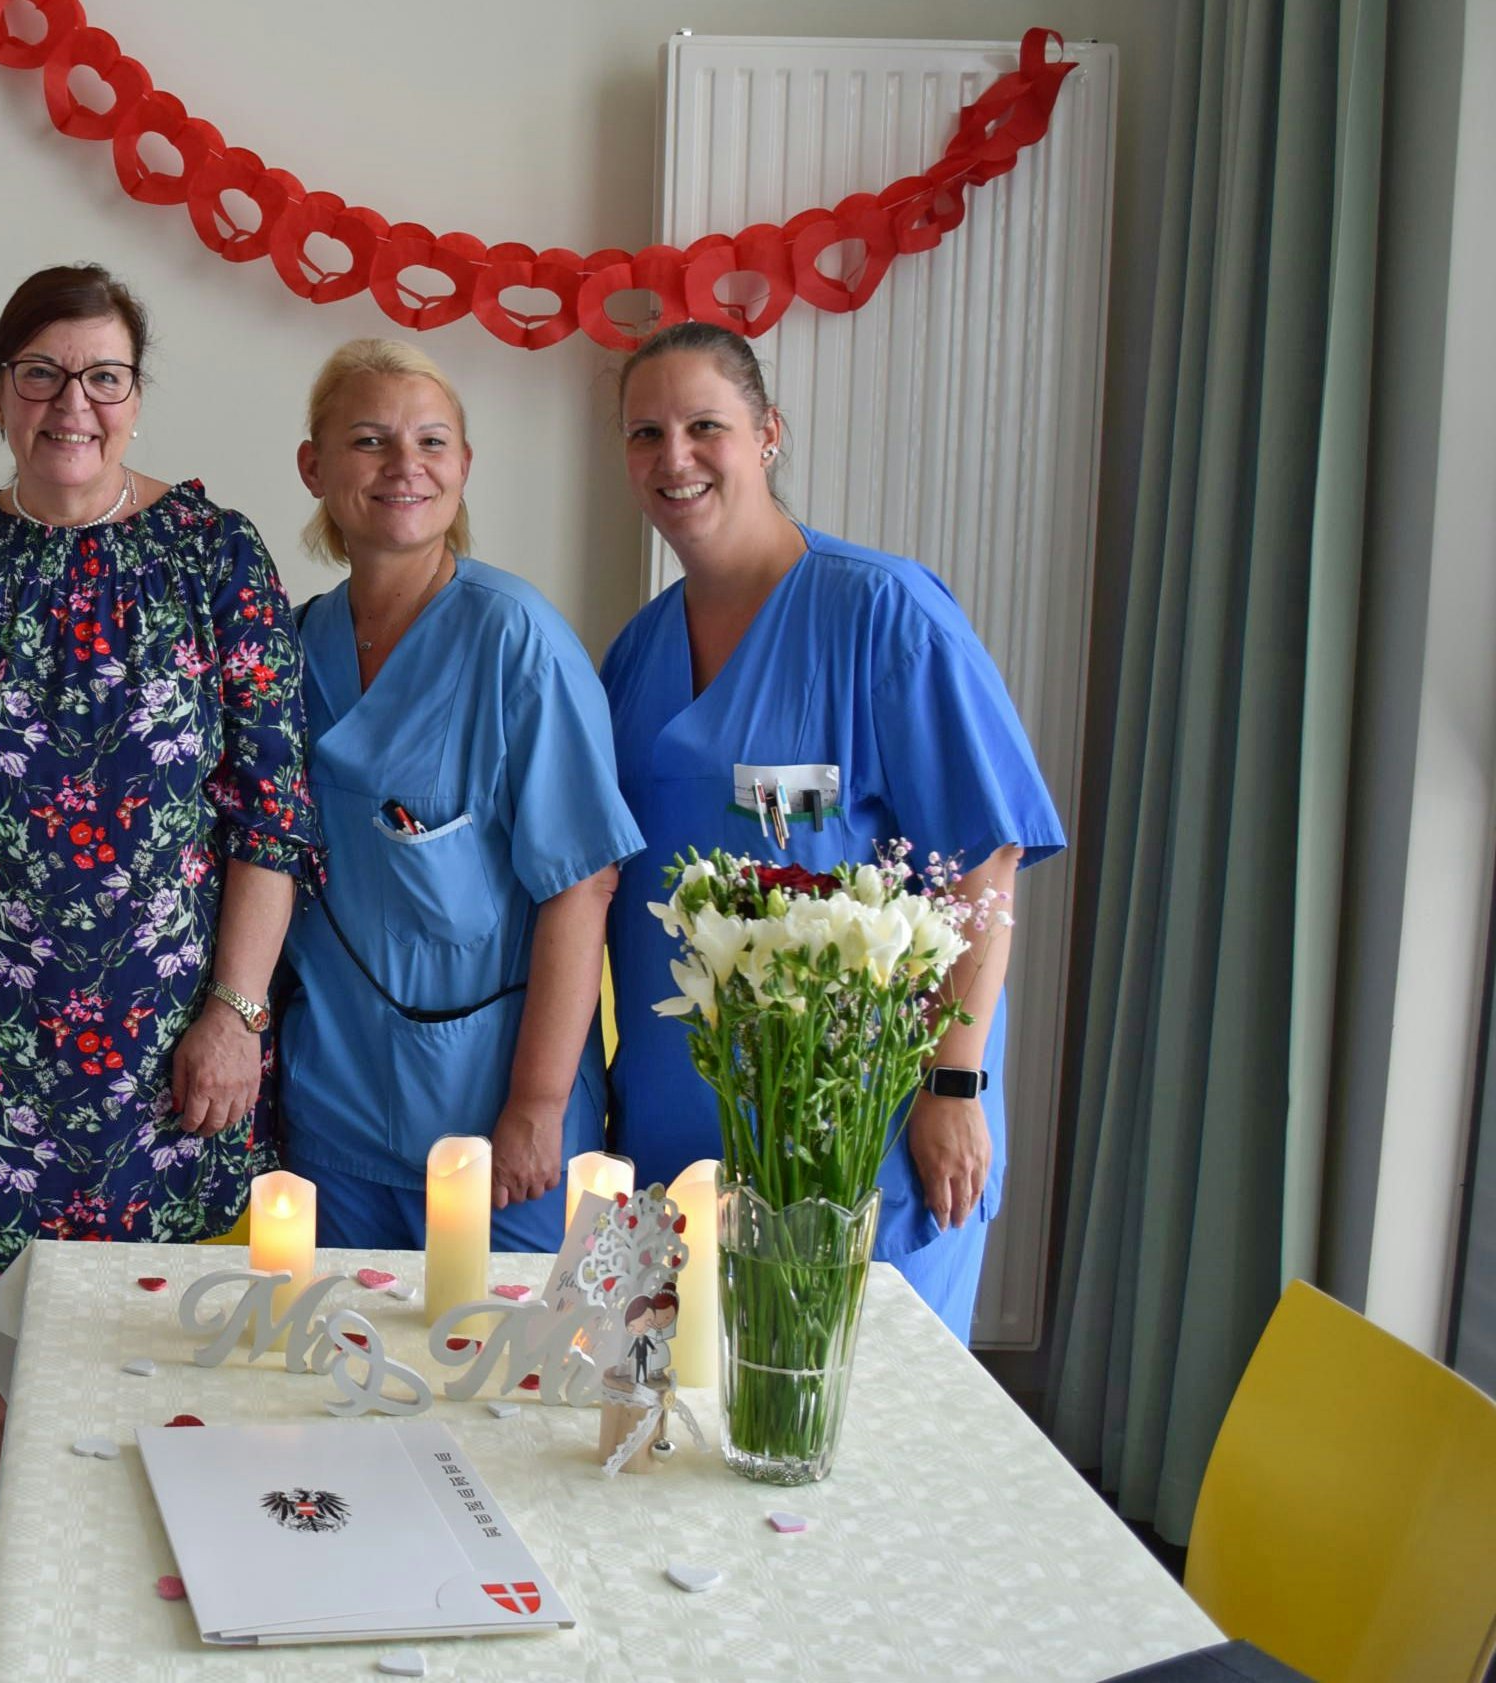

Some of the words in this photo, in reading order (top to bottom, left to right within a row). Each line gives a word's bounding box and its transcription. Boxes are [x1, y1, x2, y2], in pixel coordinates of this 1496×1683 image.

[179, 1269, 348, 1375] Mr
[323, 1309, 432, 1417] &
[429, 1300, 605, 1409] Mr
[434, 1452, 502, 1538] URKUNDE
